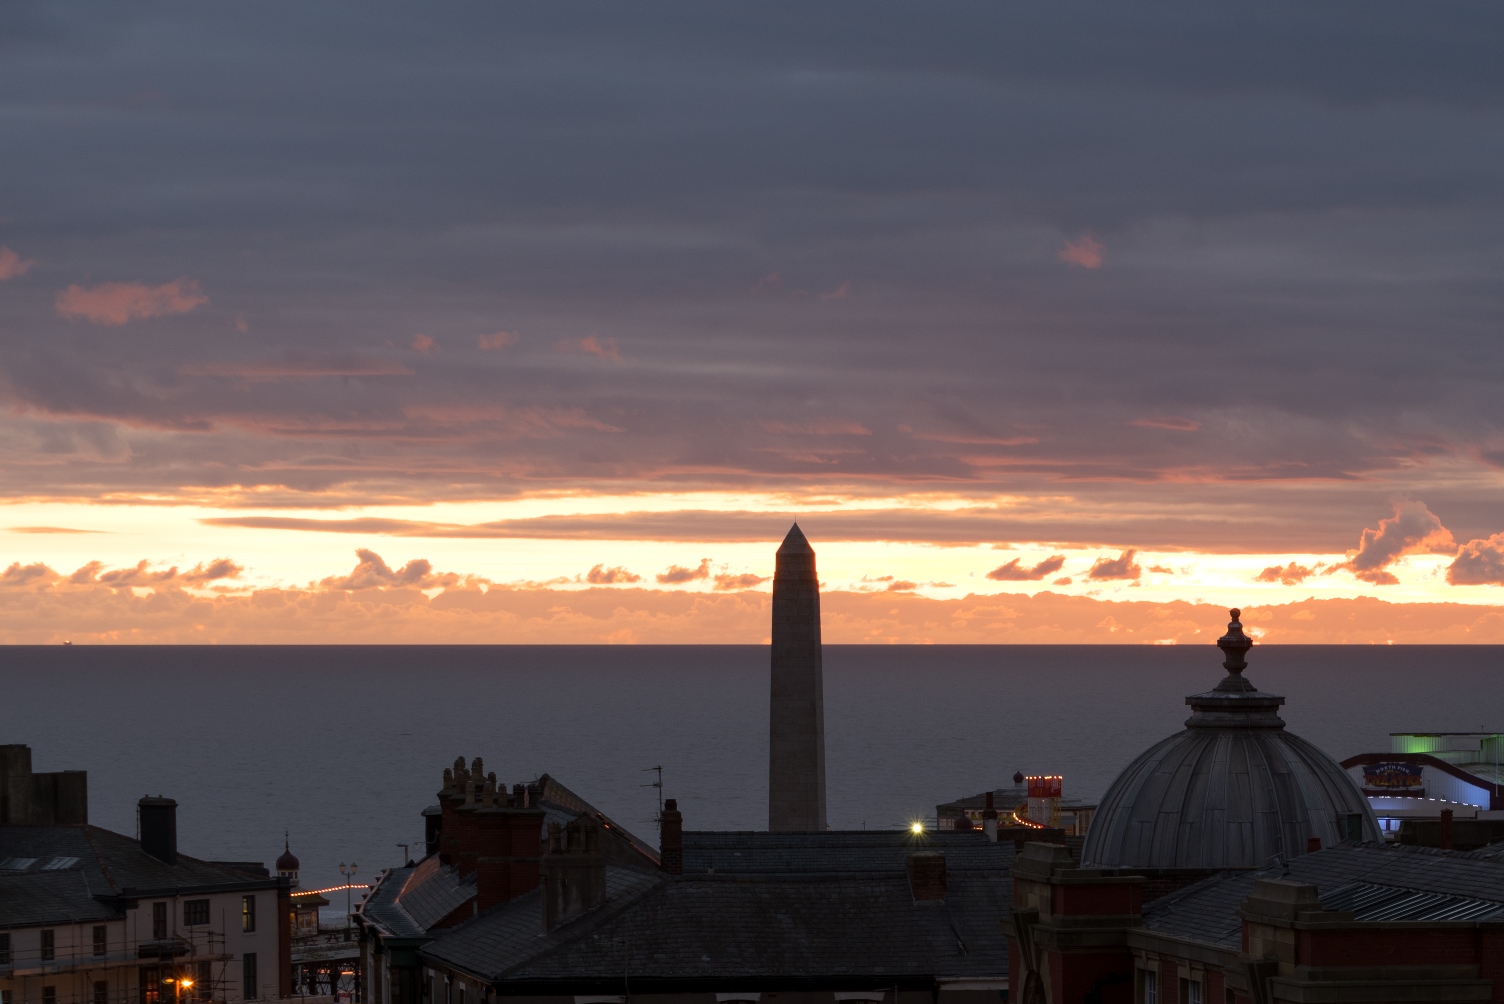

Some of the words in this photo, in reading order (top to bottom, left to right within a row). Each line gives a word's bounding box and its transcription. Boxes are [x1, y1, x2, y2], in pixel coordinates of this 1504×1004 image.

[1375, 766, 1396, 775] NORTH
[1397, 765, 1410, 774] PIER
[1364, 774, 1423, 787] THEATRE
